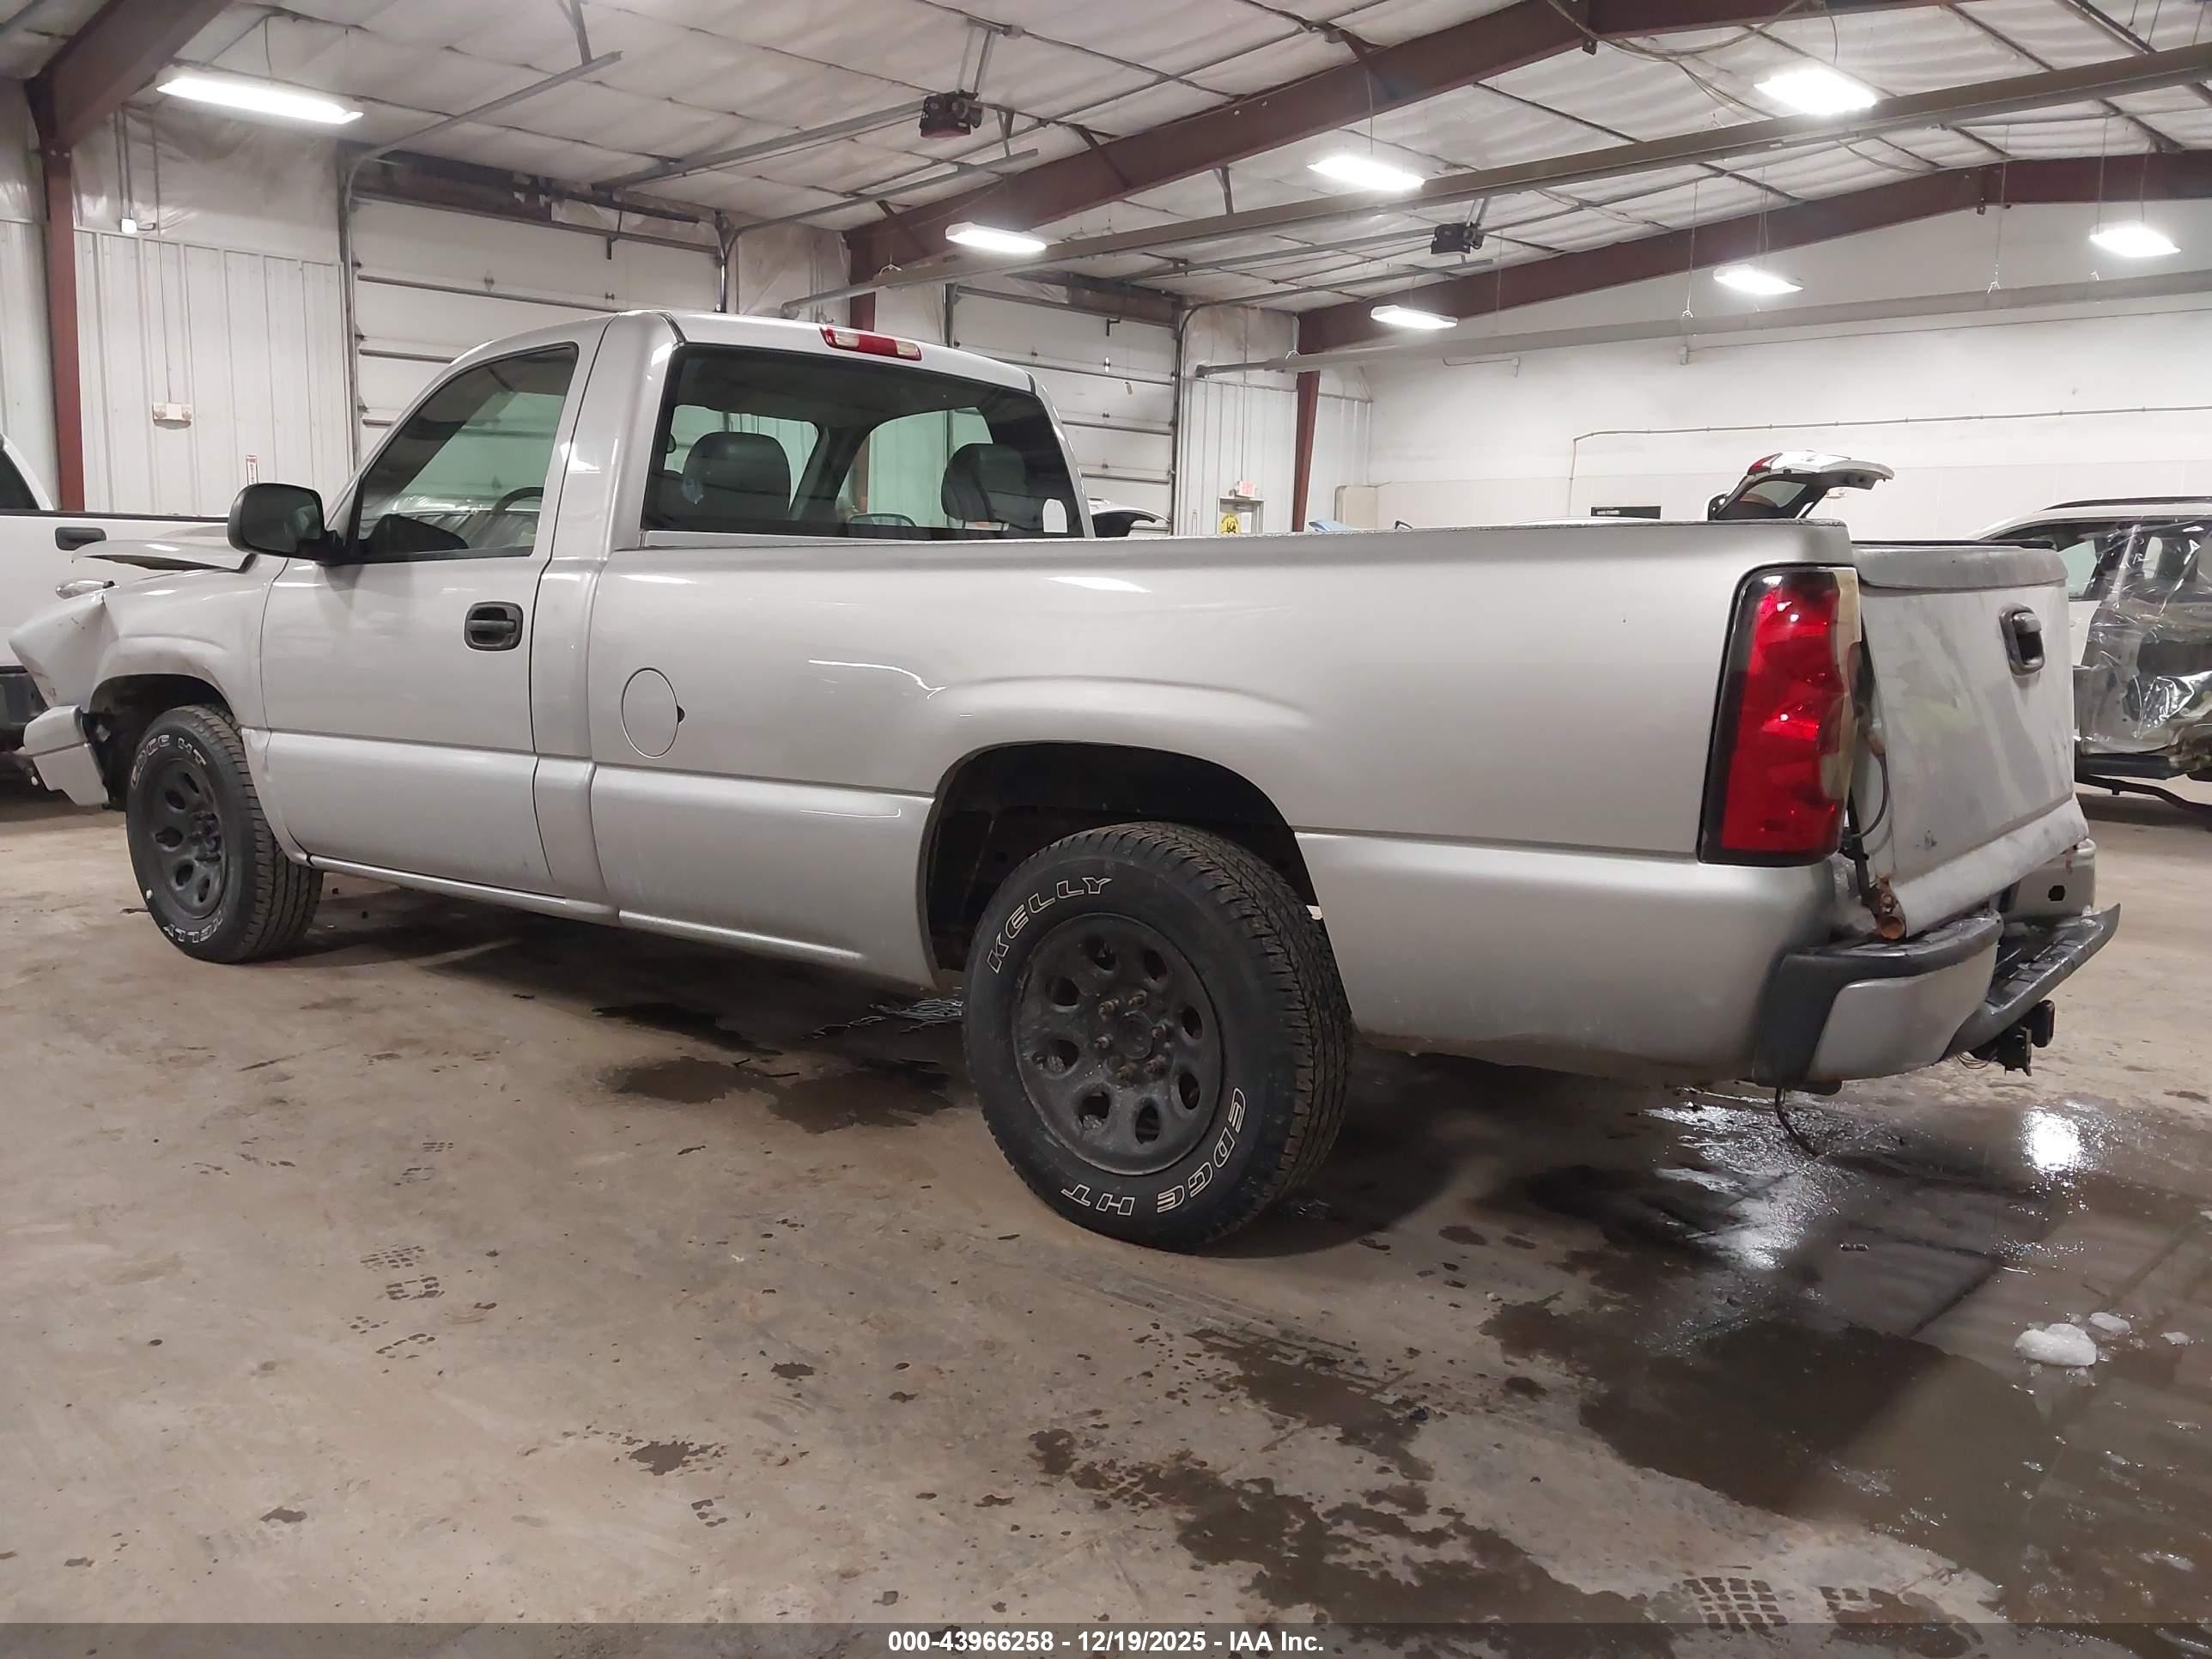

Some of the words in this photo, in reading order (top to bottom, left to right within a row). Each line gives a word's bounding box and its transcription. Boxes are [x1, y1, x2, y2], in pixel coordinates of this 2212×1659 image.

[162, 909, 224, 944] KELLY
[987, 877, 1112, 975] KELLY
[1157, 1086, 1248, 1213] EDGE
[1060, 1183, 1136, 1217] HT
